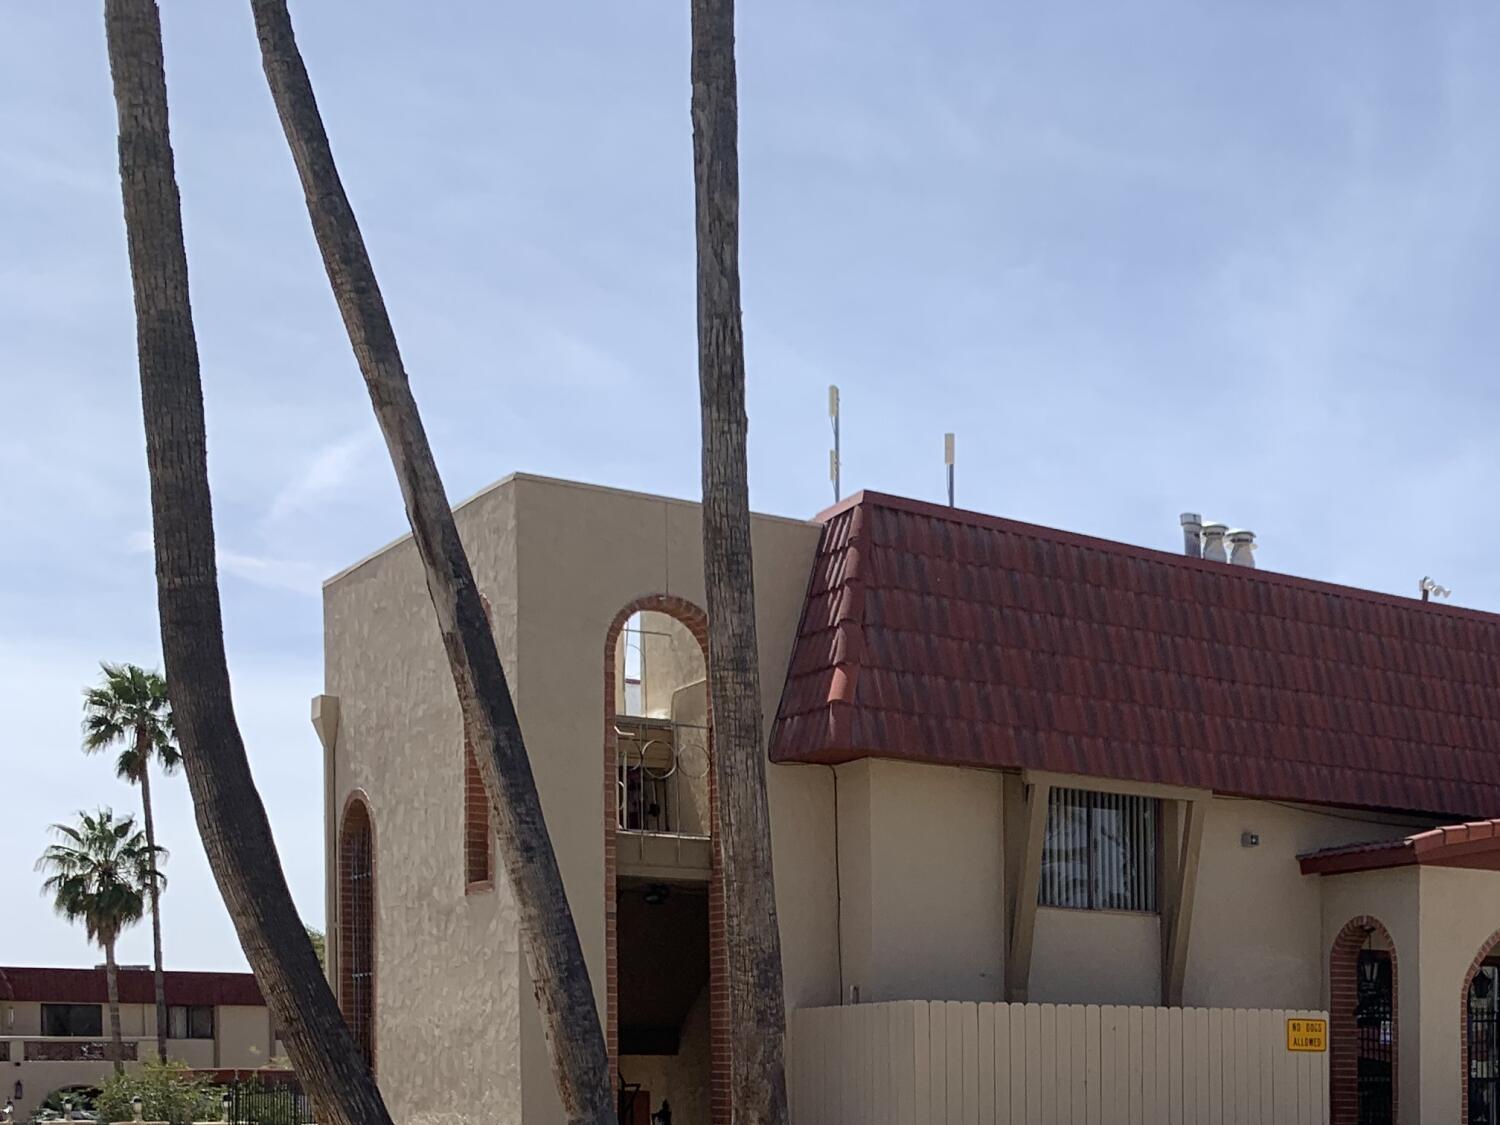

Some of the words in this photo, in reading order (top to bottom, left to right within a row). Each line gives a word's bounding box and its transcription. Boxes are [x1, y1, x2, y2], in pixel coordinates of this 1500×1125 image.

[1292, 1023, 1301, 1033] NO
[1306, 1023, 1322, 1033] DOGS
[1293, 1037, 1322, 1048] ALLOWED
